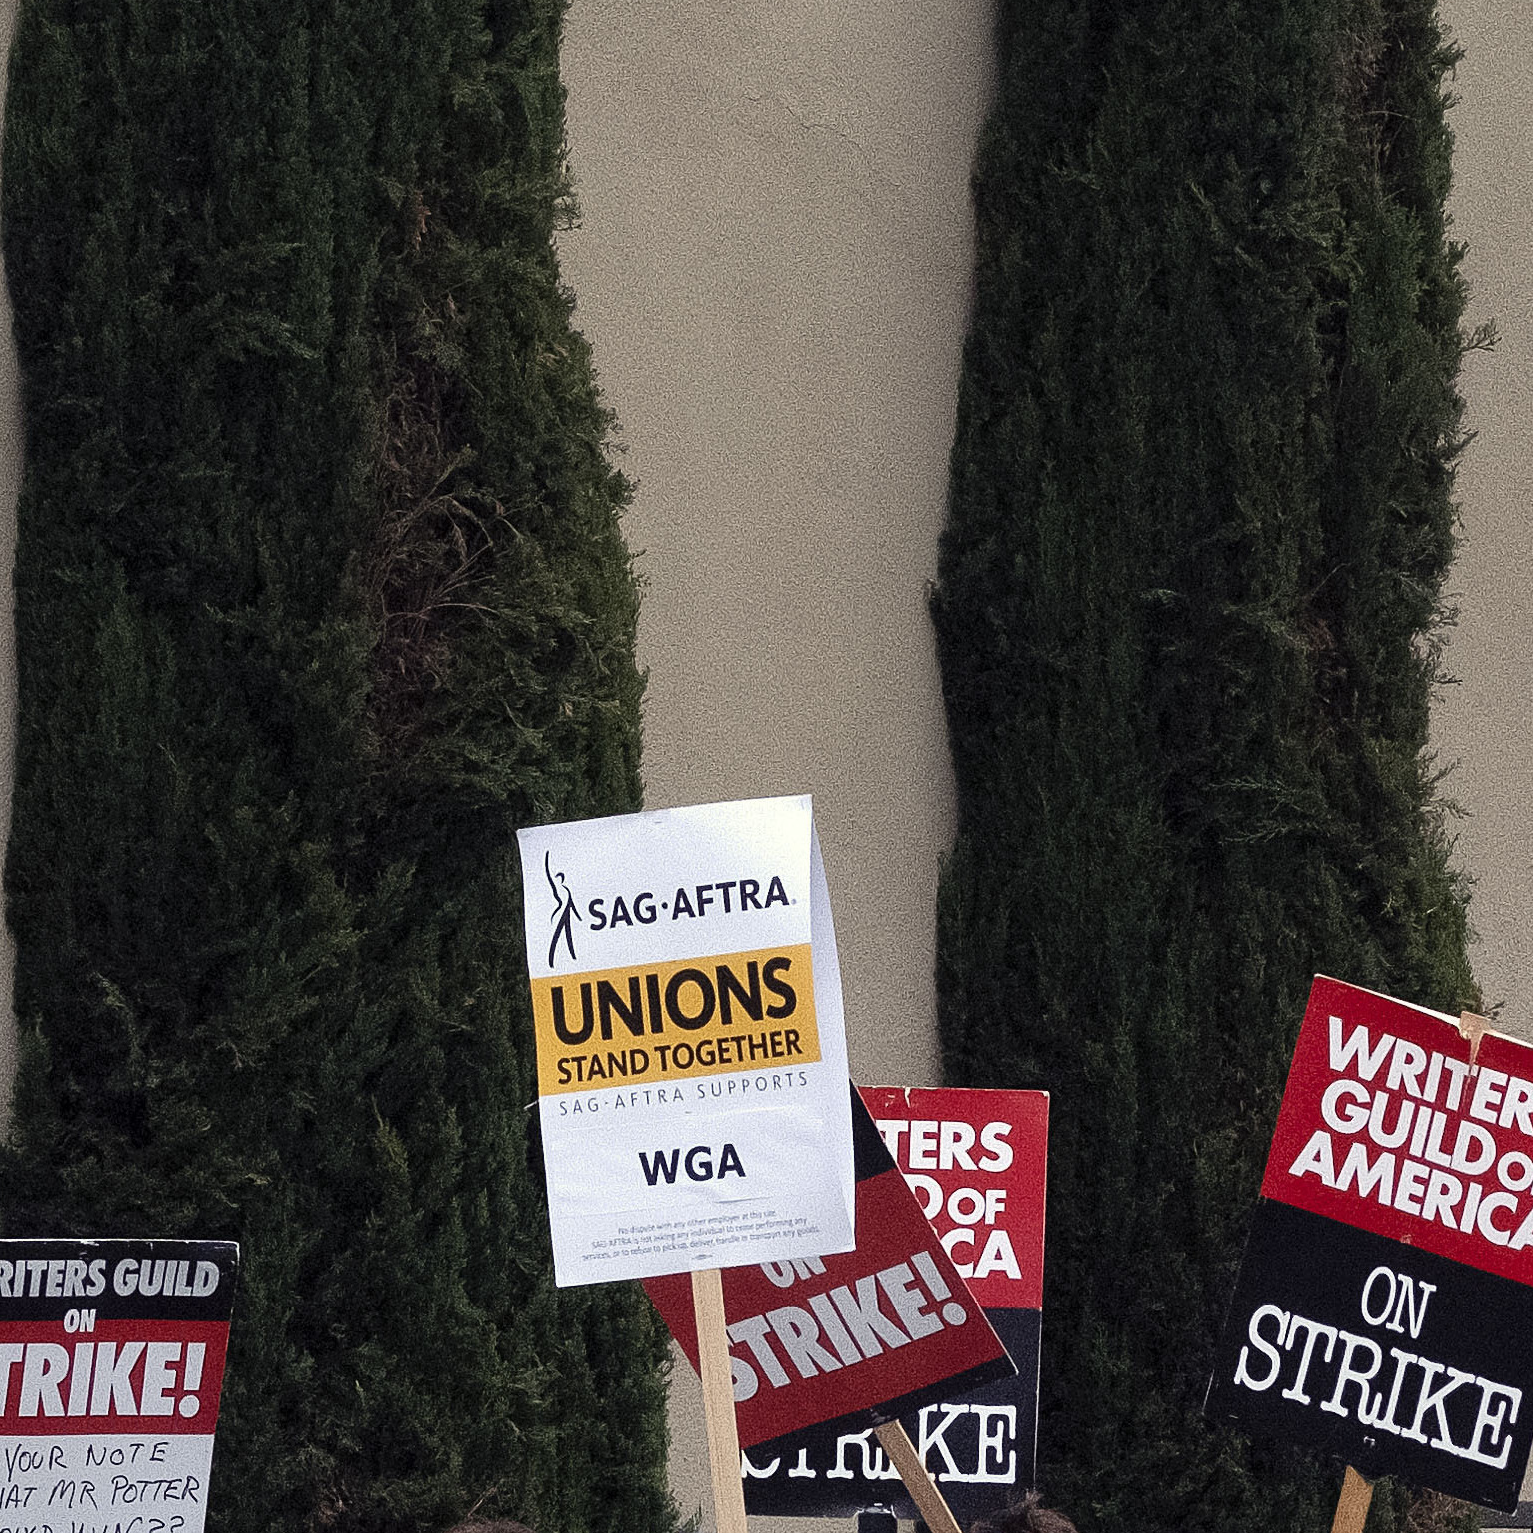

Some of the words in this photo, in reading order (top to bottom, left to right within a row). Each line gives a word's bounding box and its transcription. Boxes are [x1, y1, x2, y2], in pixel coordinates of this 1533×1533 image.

[550, 956, 798, 1046] UNIONS
[557, 1048, 651, 1086] STAND
[654, 1029, 804, 1074] TOGETHER
[697, 1071, 809, 1099] SUPPORTS
[875, 1120, 1014, 1173] TERS
[1321, 1081, 1498, 1175] GUILD
[638, 1143, 747, 1187] WGA
[947, 1187, 1007, 1225] OF
[113, 1260, 220, 1298] GUILD
[64, 1309, 96, 1333] ON
[1361, 1266, 1437, 1339] ON
[1234, 1303, 1522, 1470] STRIKE
[5, 1444, 67, 1482] YOUR
[86, 1441, 169, 1466] NOTE
[48, 1480, 96, 1510] MR
[111, 1475, 200, 1506] POTTER
